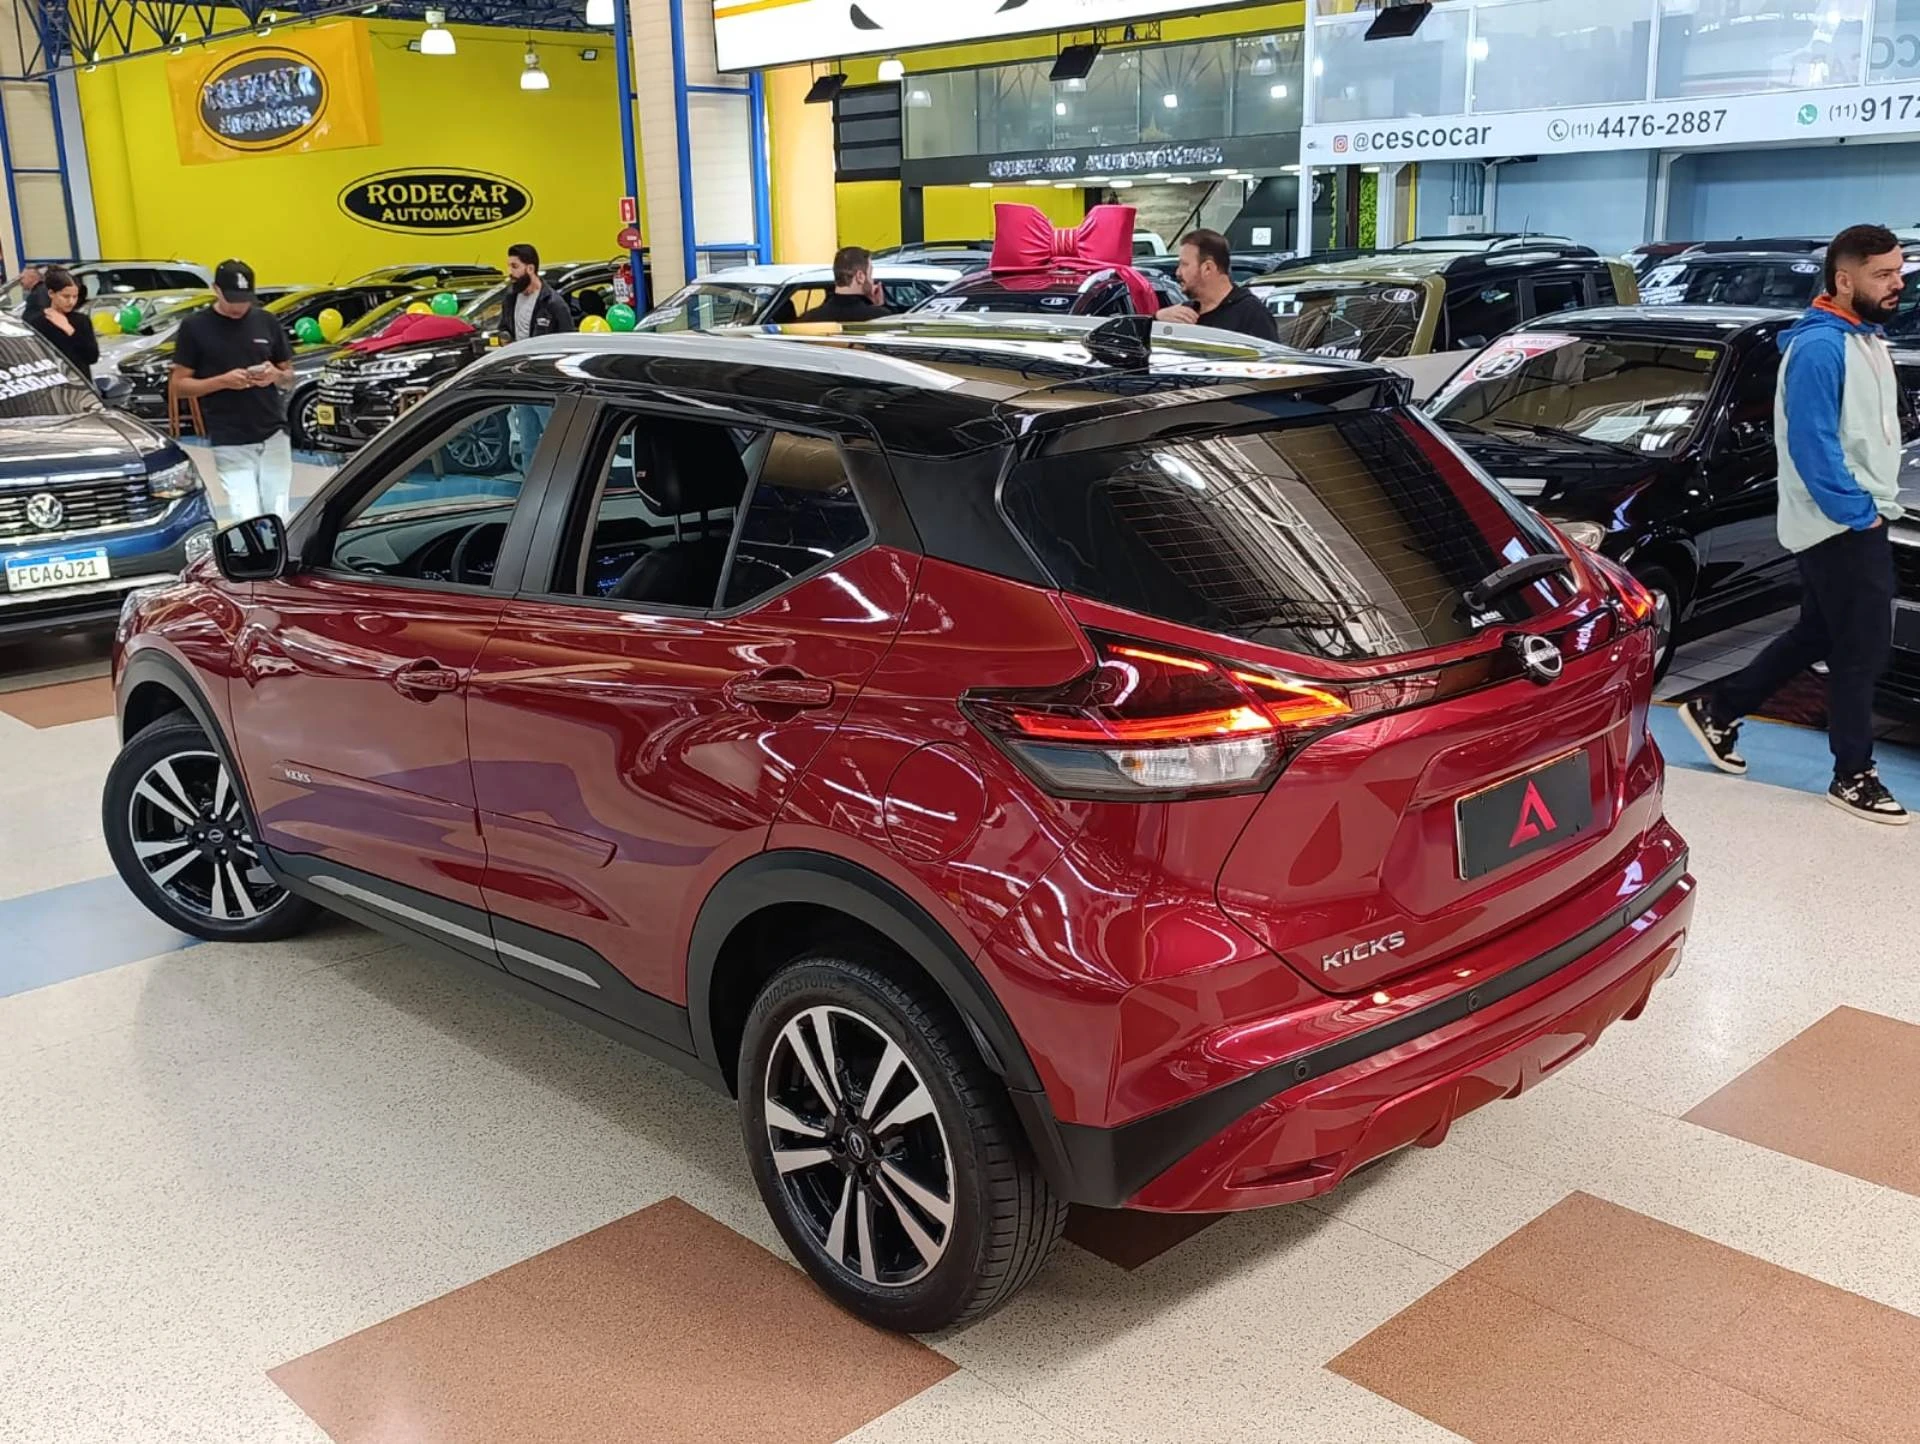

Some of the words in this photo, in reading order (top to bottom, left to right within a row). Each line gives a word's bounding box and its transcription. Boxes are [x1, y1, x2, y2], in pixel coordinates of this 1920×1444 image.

[1353, 125, 1492, 152] @cescocar
[366, 183, 509, 206] RODECAR
[380, 203, 503, 222] AUTOMÓVEIS
[9, 358, 57, 377] SOLAR
[17, 560, 98, 585] FCA6J21
[1321, 930, 1406, 972] KICKS
